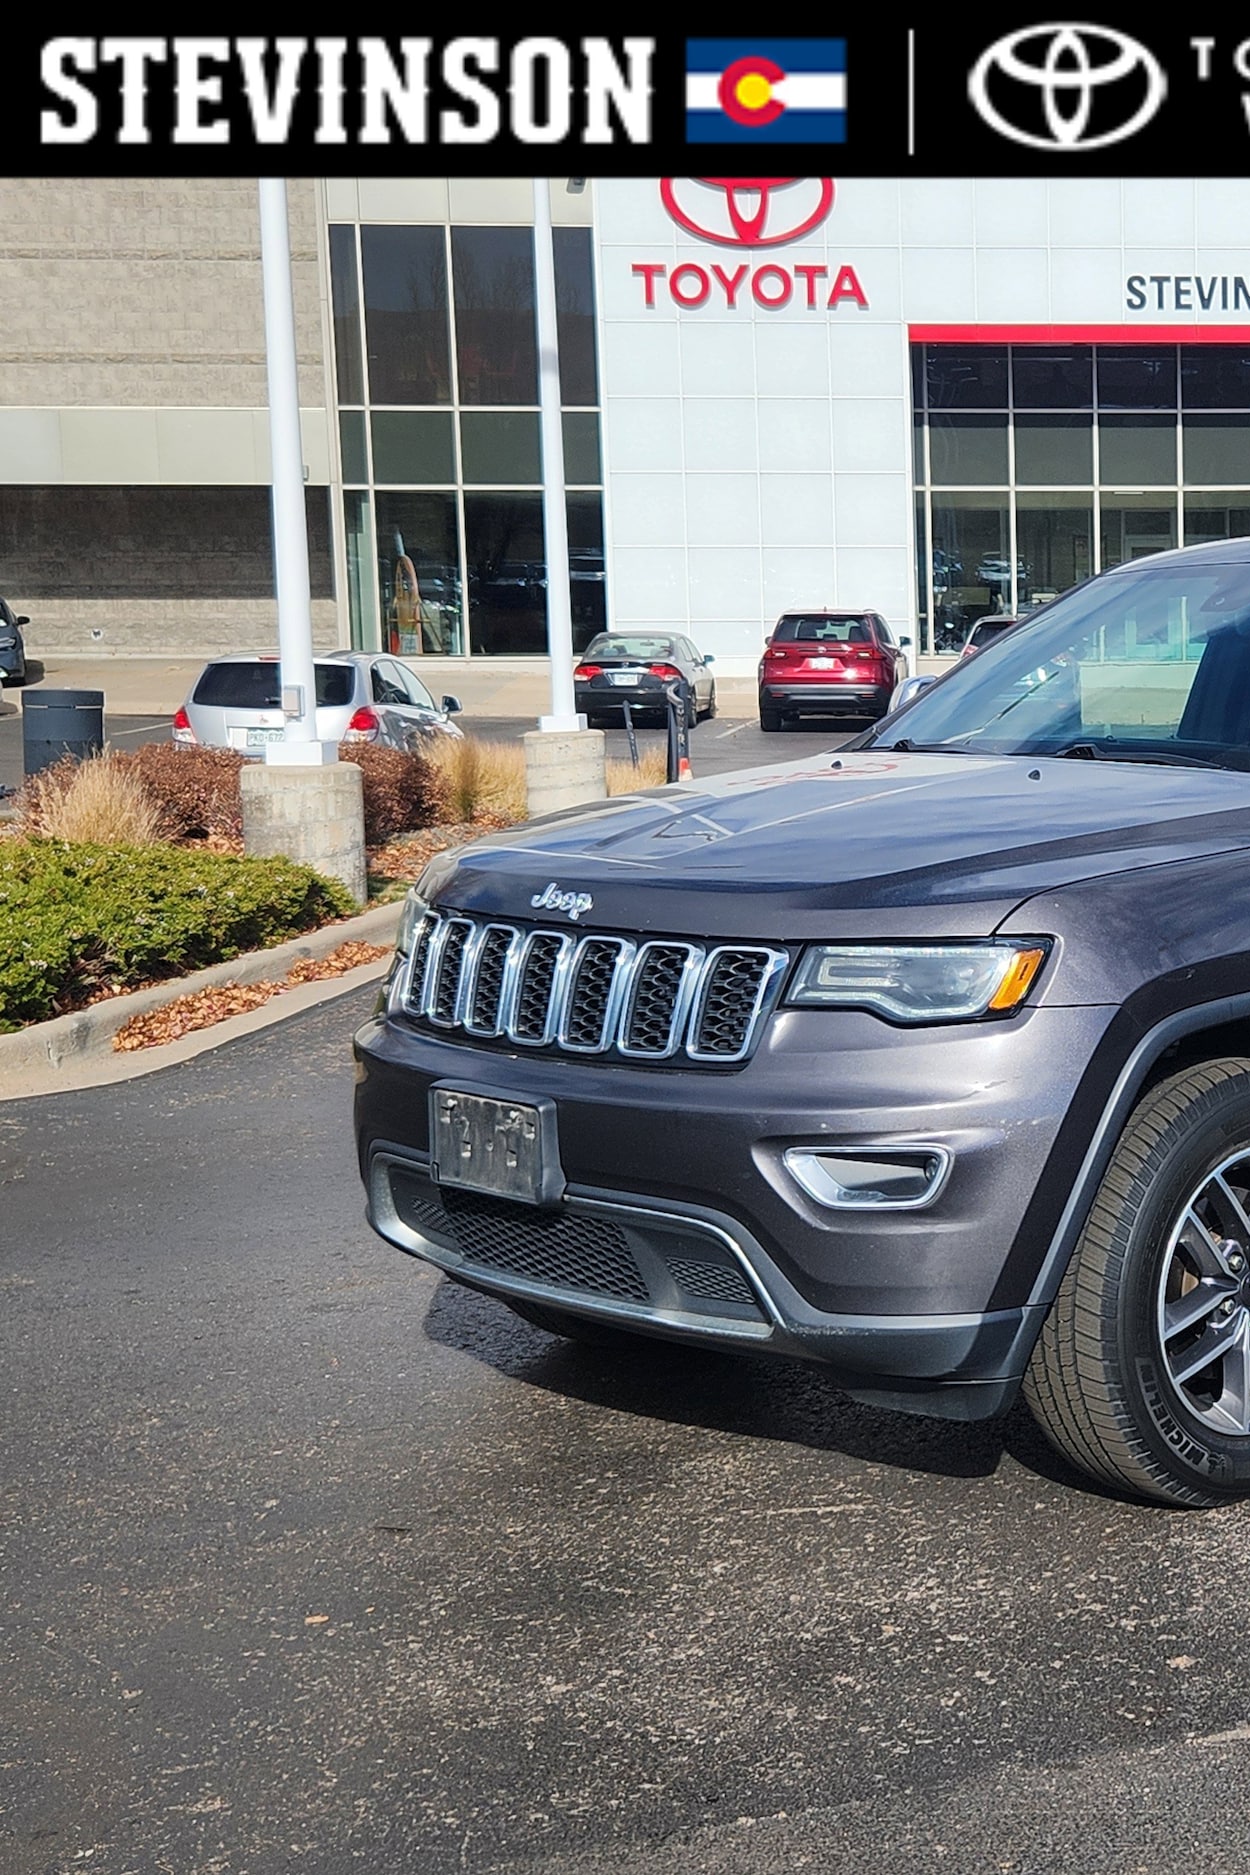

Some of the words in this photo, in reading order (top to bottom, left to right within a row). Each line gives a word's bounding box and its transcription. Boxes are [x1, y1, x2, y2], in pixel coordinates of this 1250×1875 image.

[633, 263, 867, 309] TOYOTA
[531, 882, 593, 921] Jeep
[1139, 1364, 1206, 1466] MICHELIN
